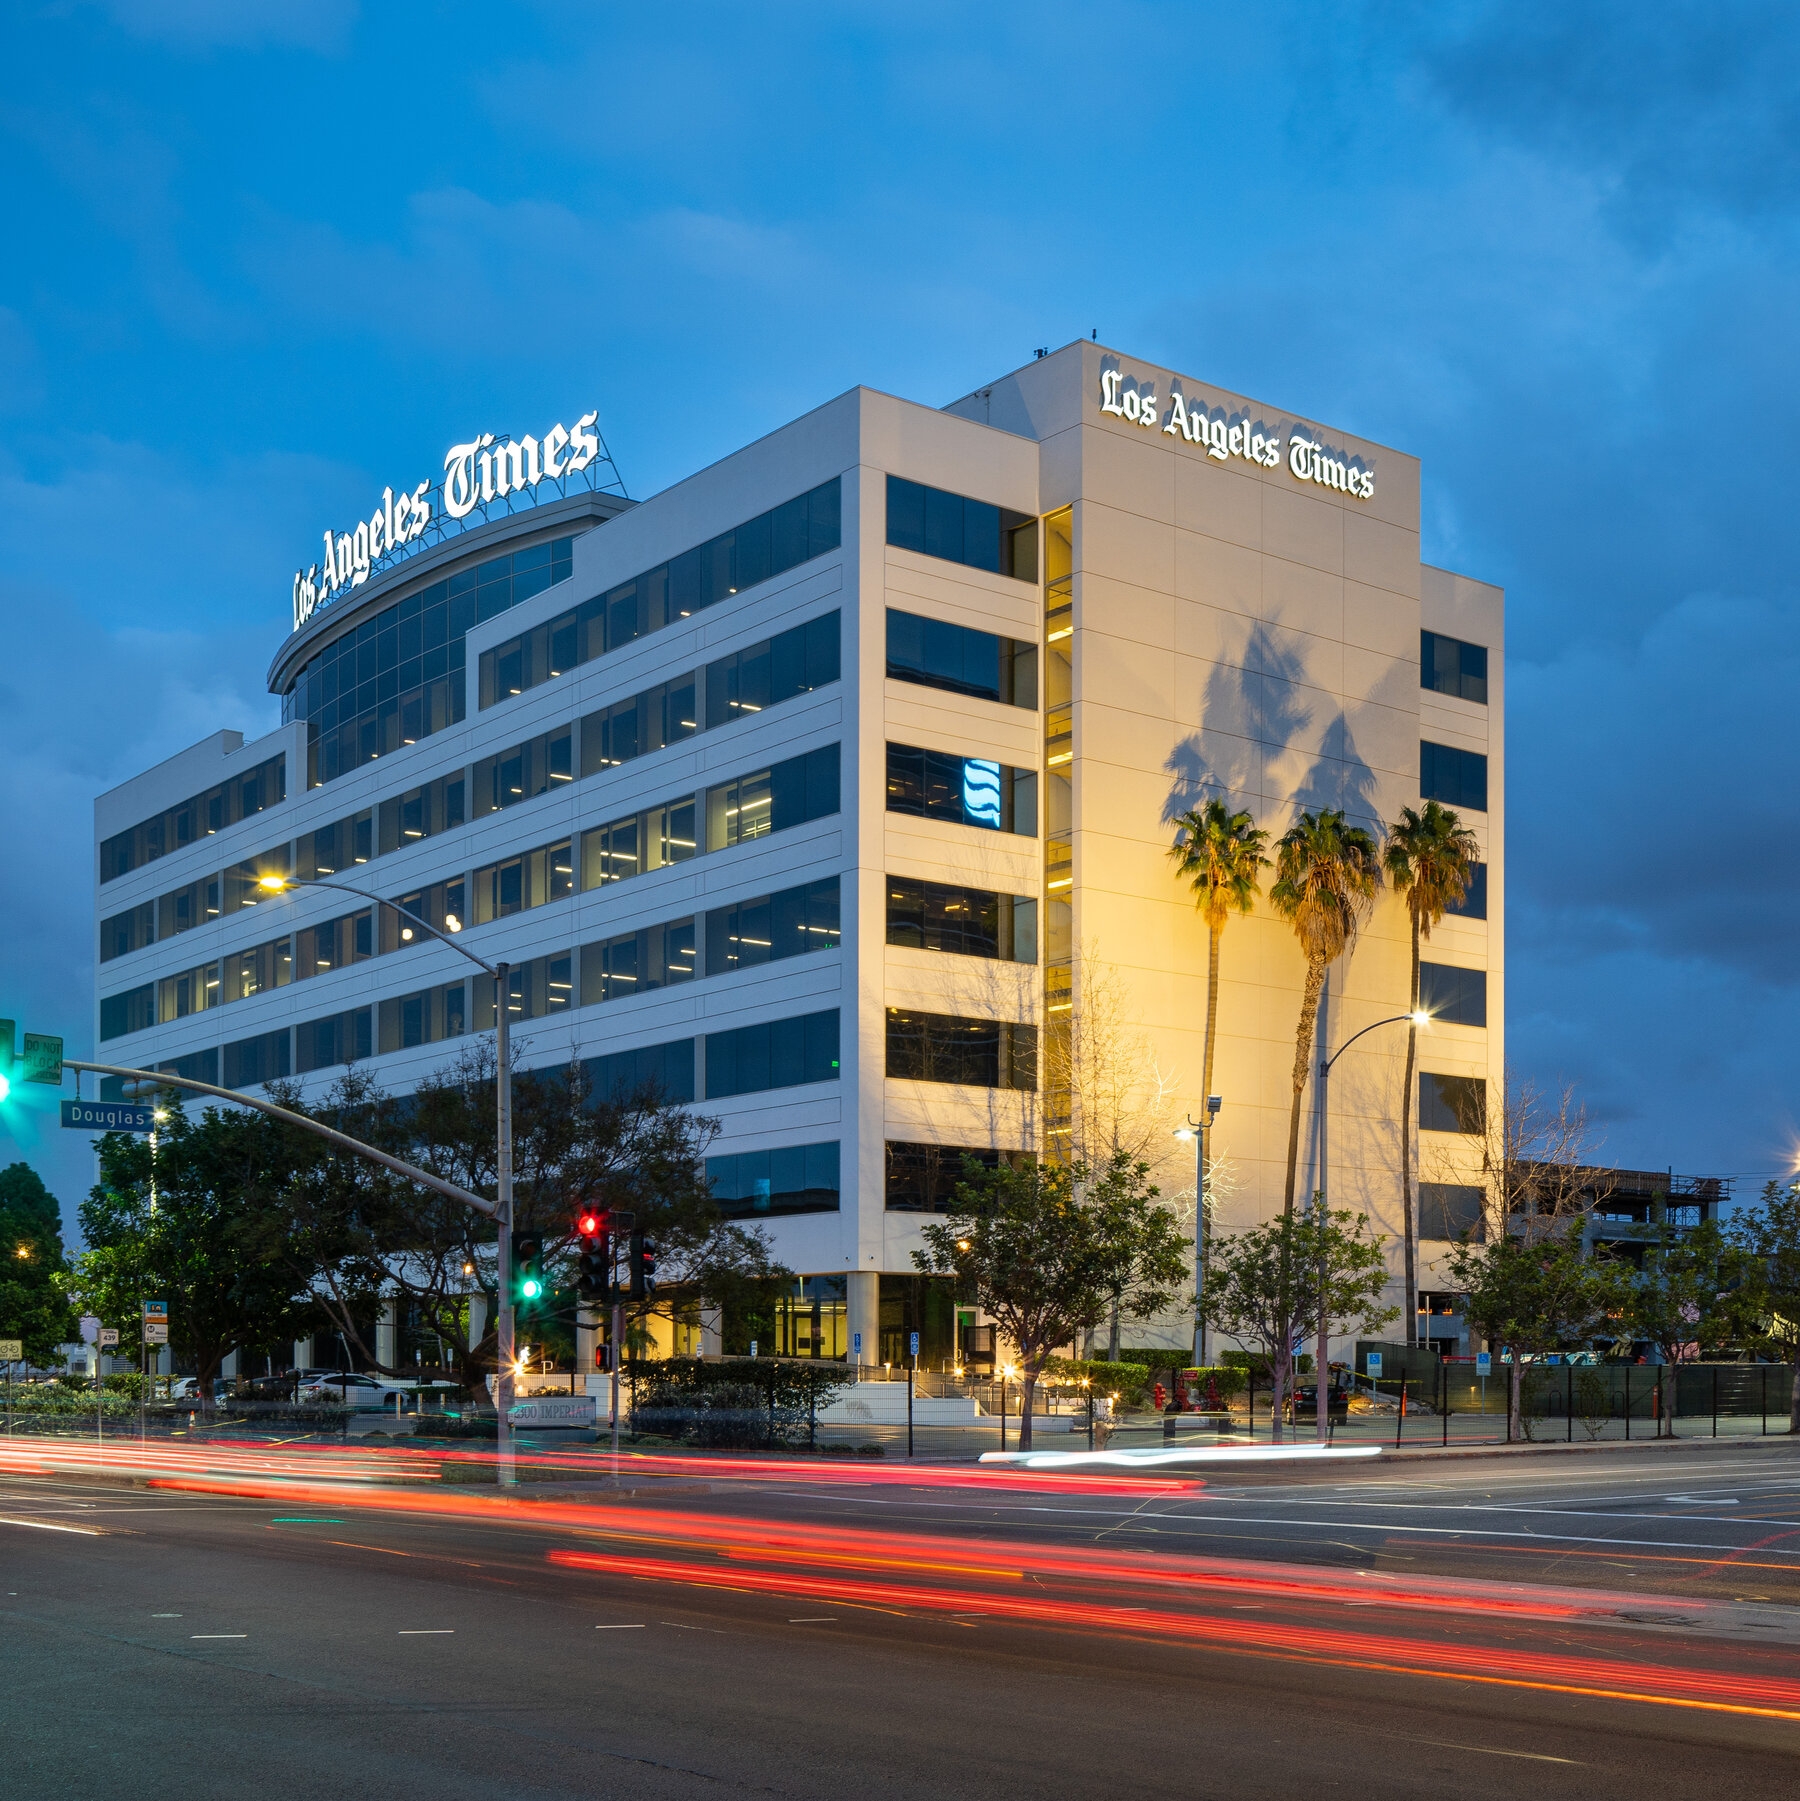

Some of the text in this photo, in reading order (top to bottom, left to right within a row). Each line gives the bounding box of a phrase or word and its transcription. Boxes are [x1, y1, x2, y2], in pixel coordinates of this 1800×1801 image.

[1100, 369, 1374, 499] Los Angeles Times
[293, 410, 599, 632] Los Angeles Times
[26, 1040, 61, 1054] DO NOT
[25, 1055, 61, 1070] BLOCK
[72, 1107, 145, 1128] Douglas
[541, 1405, 588, 1419] IMPERIAL
